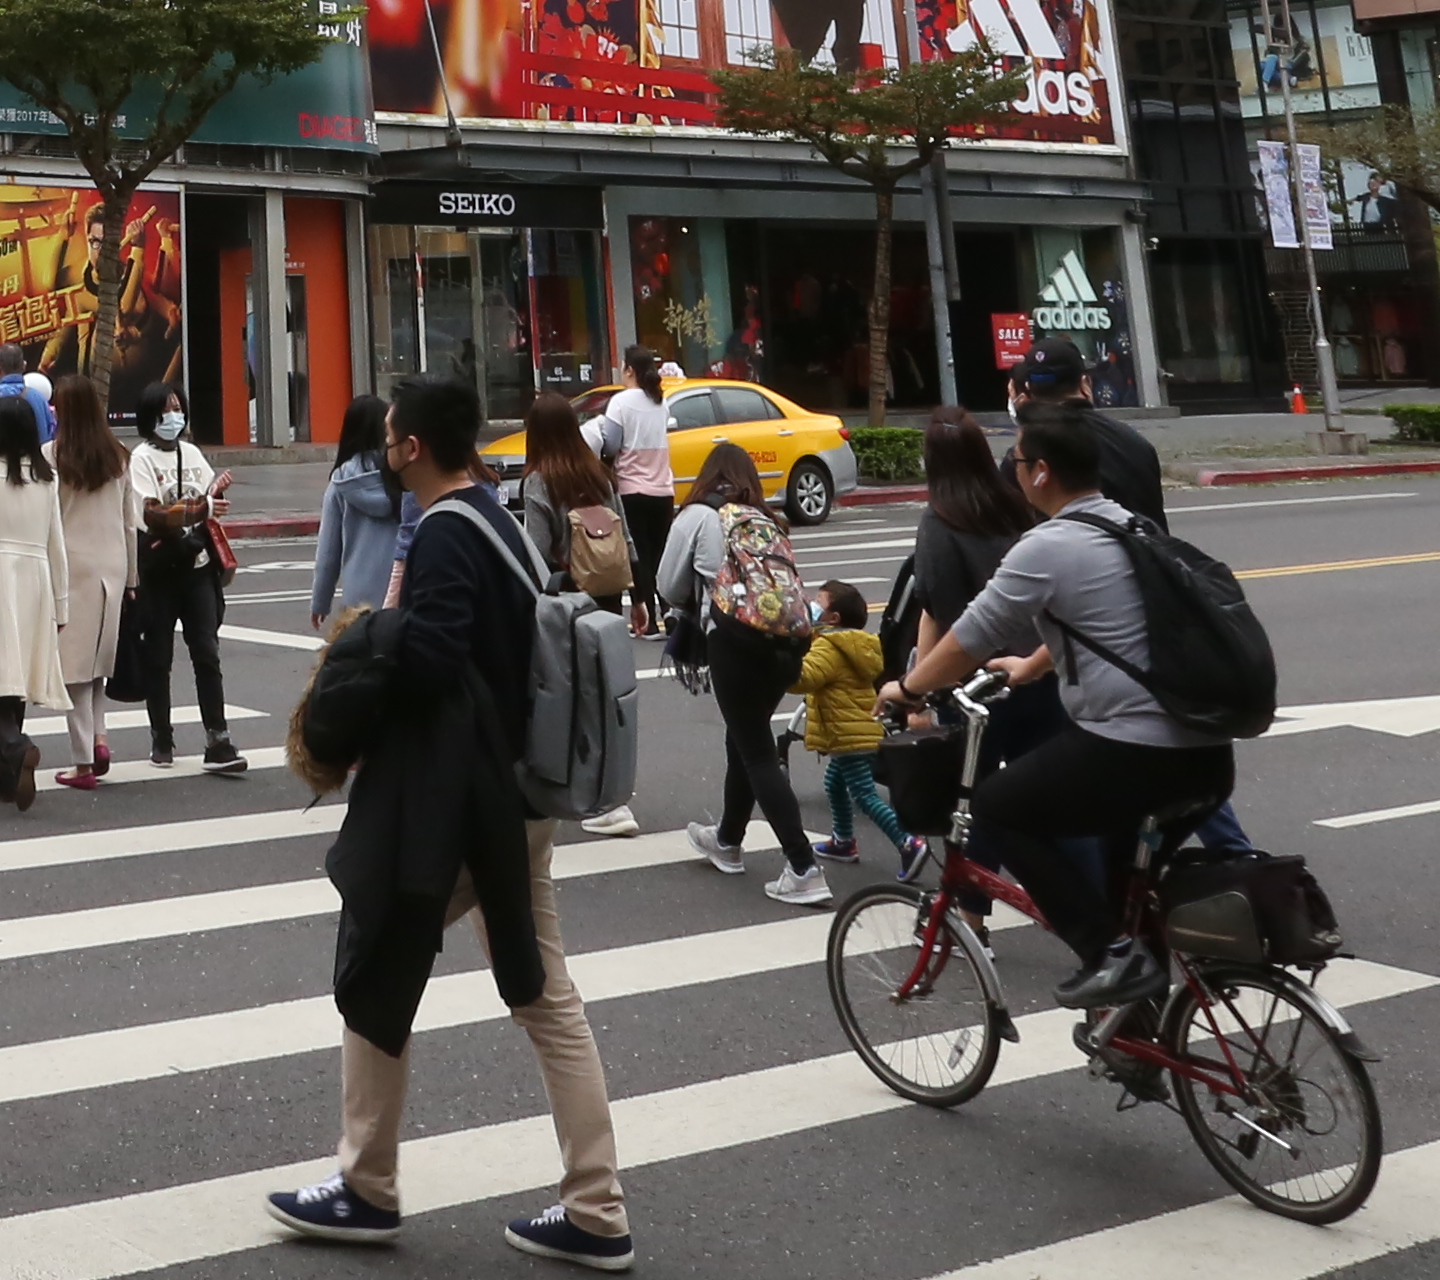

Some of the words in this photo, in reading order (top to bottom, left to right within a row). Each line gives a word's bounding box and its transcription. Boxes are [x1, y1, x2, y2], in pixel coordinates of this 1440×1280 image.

[439, 192, 516, 216] SEIKO
[1033, 301, 1111, 329] adidas
[999, 329, 1024, 340] SALE
